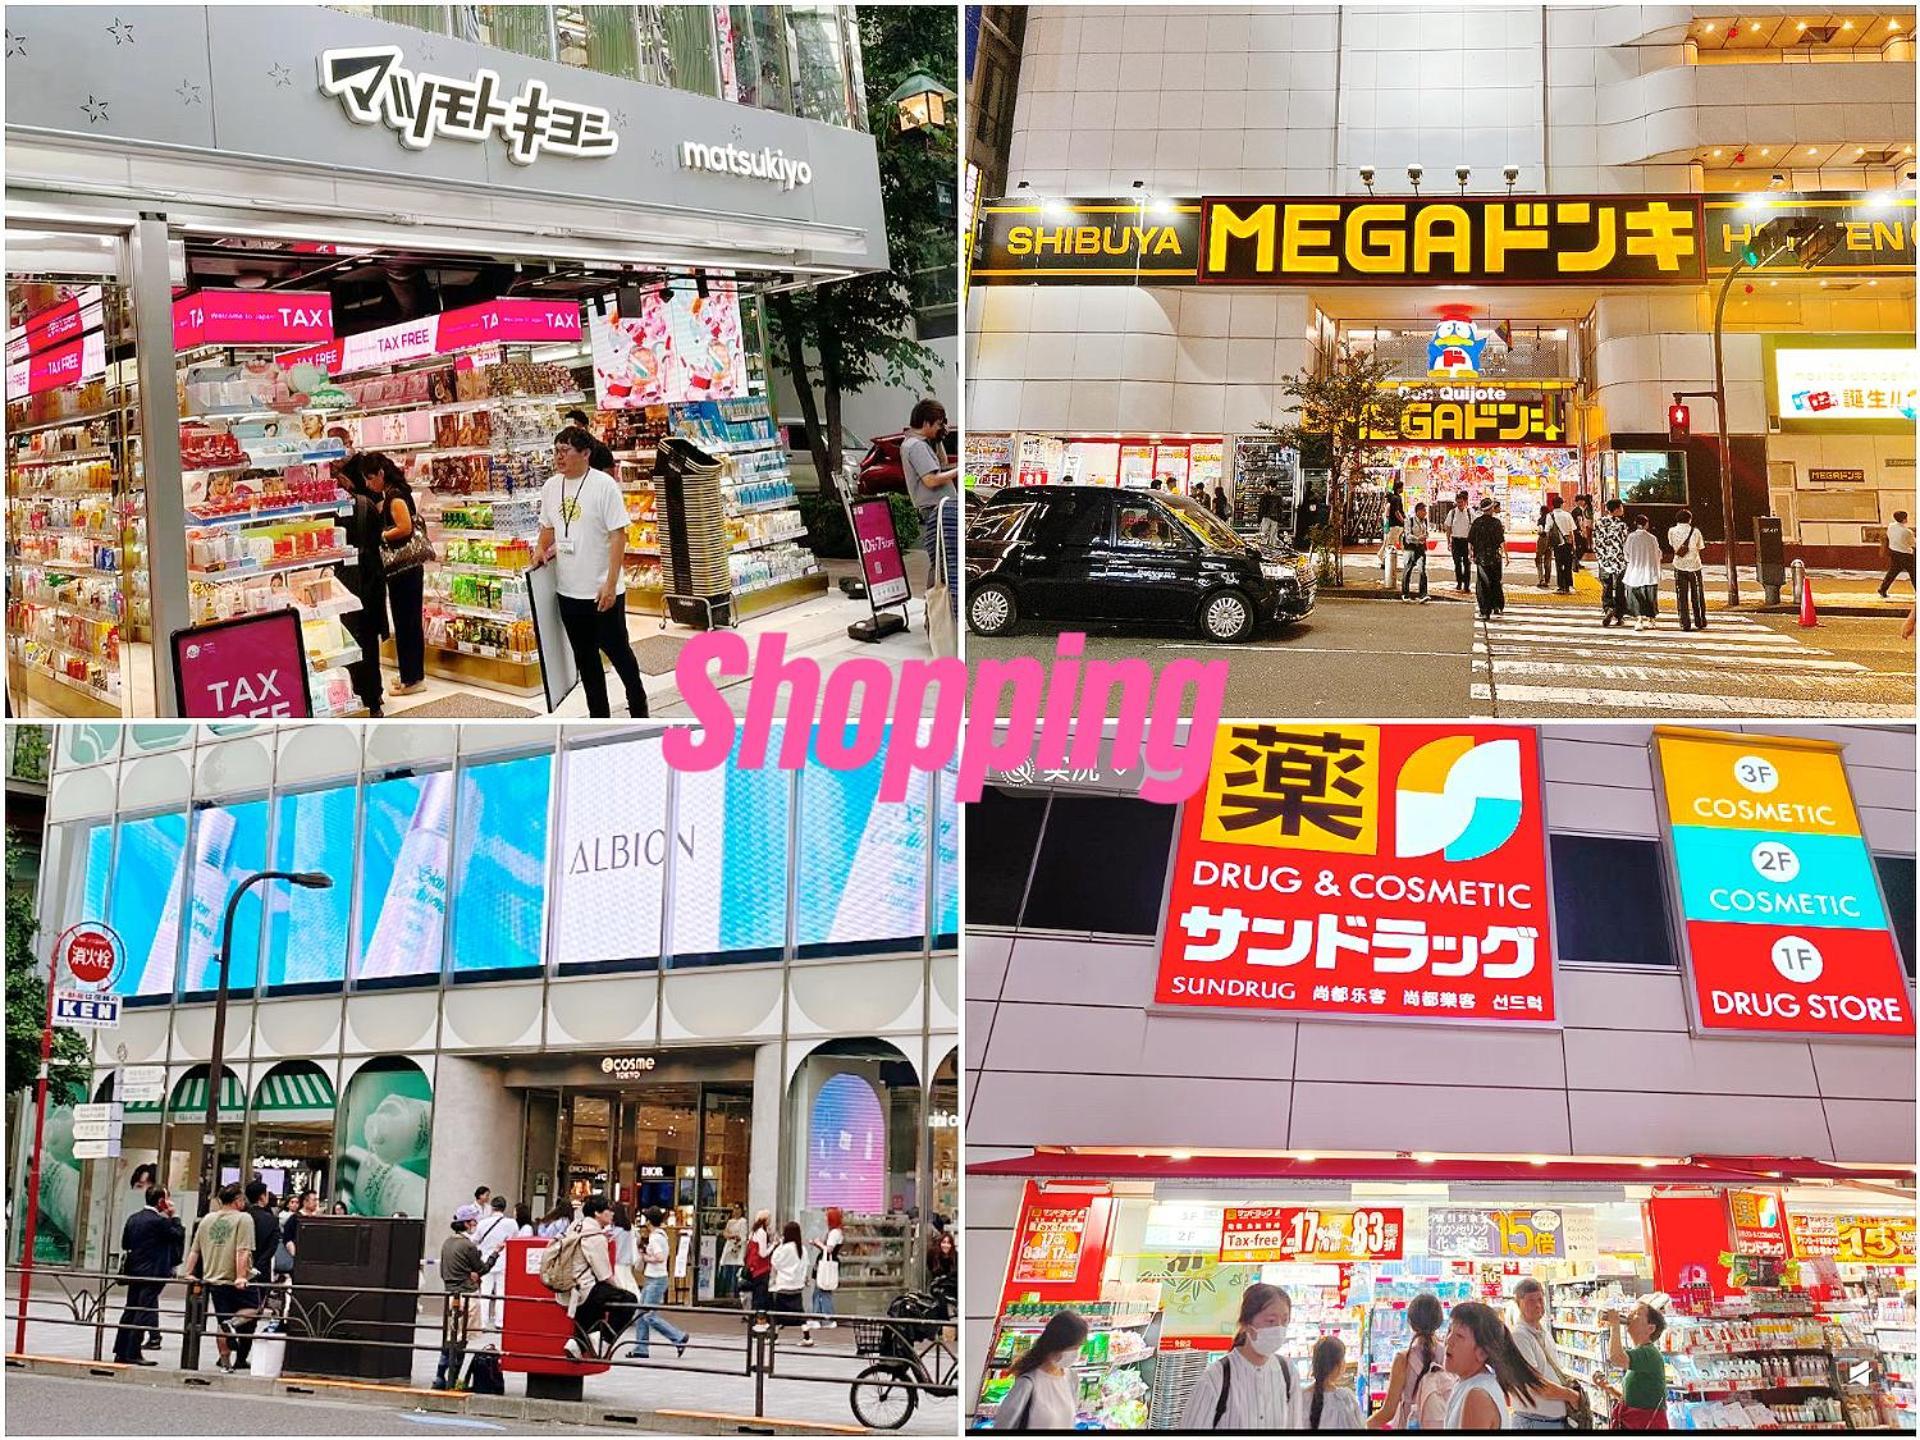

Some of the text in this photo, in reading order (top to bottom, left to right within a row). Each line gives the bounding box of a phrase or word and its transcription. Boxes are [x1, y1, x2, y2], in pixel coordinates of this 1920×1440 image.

[326, 48, 616, 158] マツモトキヨシ
[682, 139, 813, 191] matsukiyo
[1007, 225, 1183, 256] SHIBUYA
[1208, 201, 1695, 274] MEGAドンキ
[278, 307, 324, 328] TAX
[545, 312, 574, 329] TAX
[377, 328, 430, 352] TAX FREE
[61, 353, 79, 371] FREE
[315, 349, 338, 366] FREE
[1439, 387, 1507, 402] Quijote
[206, 669, 282, 712] TAX
[1217, 724, 1366, 841] 薬
[1740, 762, 1773, 784] 3F
[1693, 797, 1837, 827] COSMETIC
[568, 824, 695, 875] ALBION
[1757, 850, 1791, 873] 2F
[1191, 860, 1533, 910] DRUG & COSMETIC
[1708, 888, 1862, 918] COSMETIC
[1179, 905, 1540, 979] サンドラッグ
[70, 944, 113, 970] 消火栓
[1780, 948, 1813, 971] 1F
[1171, 975, 1297, 1001] SUNDRUG
[1312, 985, 1387, 1004] 尚都乐客
[62, 1000, 113, 1020] KEN
[1711, 989, 1903, 1023] DRUG STORE
[601, 1057, 656, 1073] @cosme
[615, 1071, 641, 1080] TOKYO
[641, 1166, 664, 1177] DIOR
[1228, 1233, 1279, 1248] Tax-free
[1352, 1211, 1385, 1253] 83
[1839, 1225, 1898, 1258] 15
